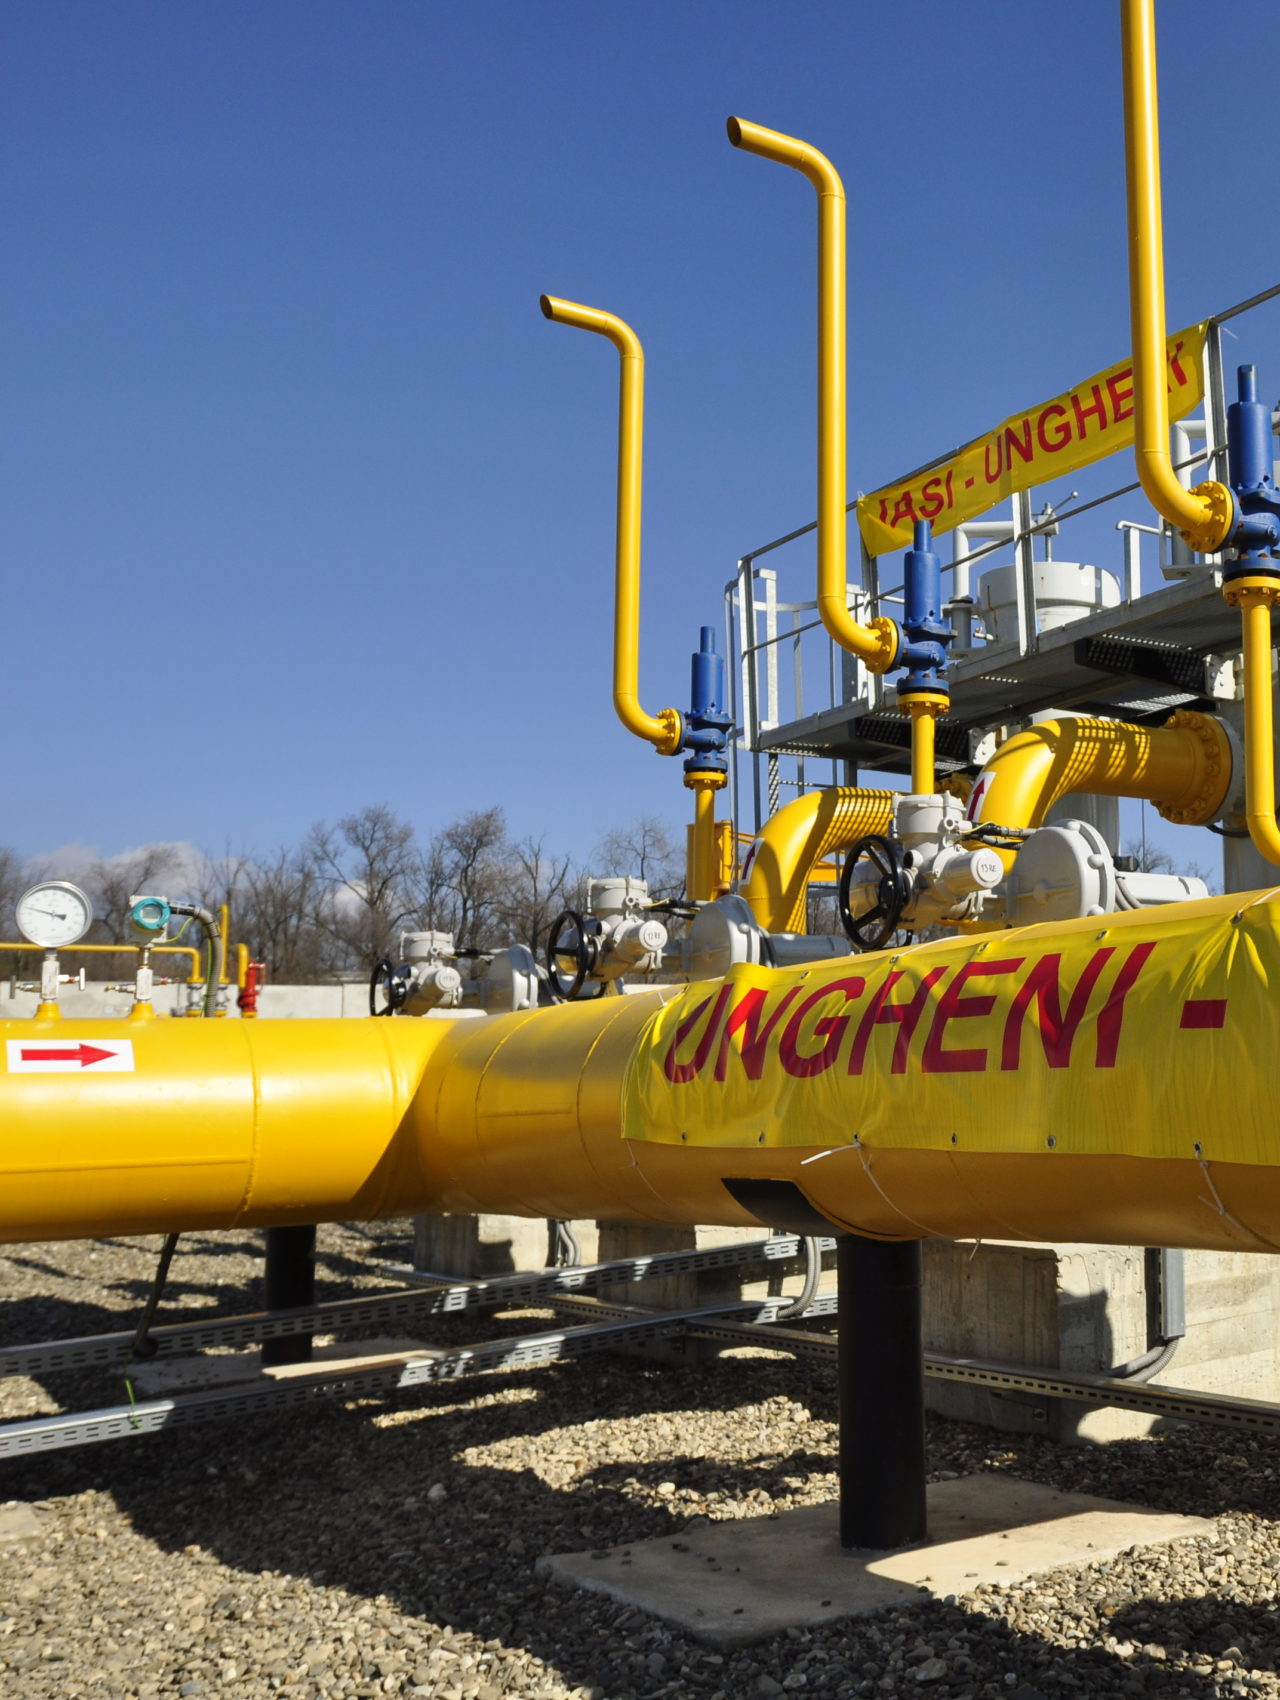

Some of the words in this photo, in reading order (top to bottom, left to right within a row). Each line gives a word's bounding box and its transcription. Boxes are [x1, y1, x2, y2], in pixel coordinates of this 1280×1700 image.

[984, 340, 1188, 485] UNGHEI
[664, 942, 1157, 1084] UNGHENI
[1179, 1000, 1227, 1028] -
